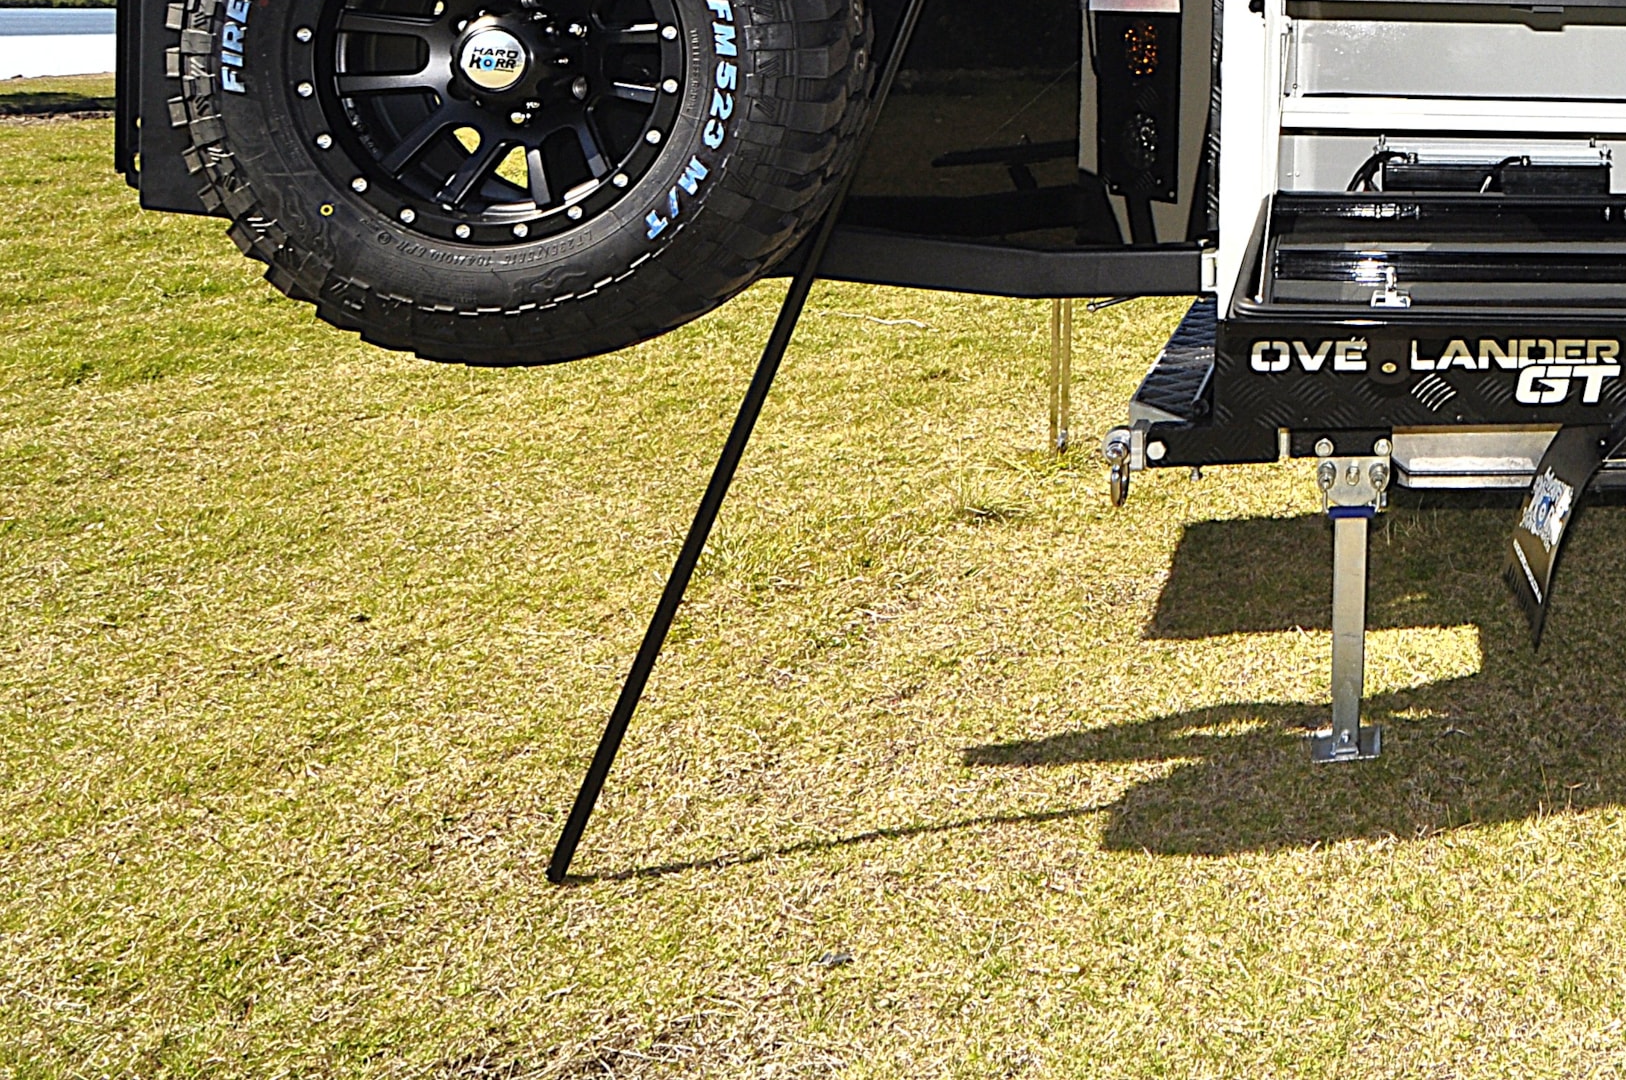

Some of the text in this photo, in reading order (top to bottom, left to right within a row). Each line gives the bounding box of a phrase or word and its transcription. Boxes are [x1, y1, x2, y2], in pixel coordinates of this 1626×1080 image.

[473, 46, 519, 59] HARD
[645, 155, 710, 240] M/T
[1515, 365, 1621, 403] GT
